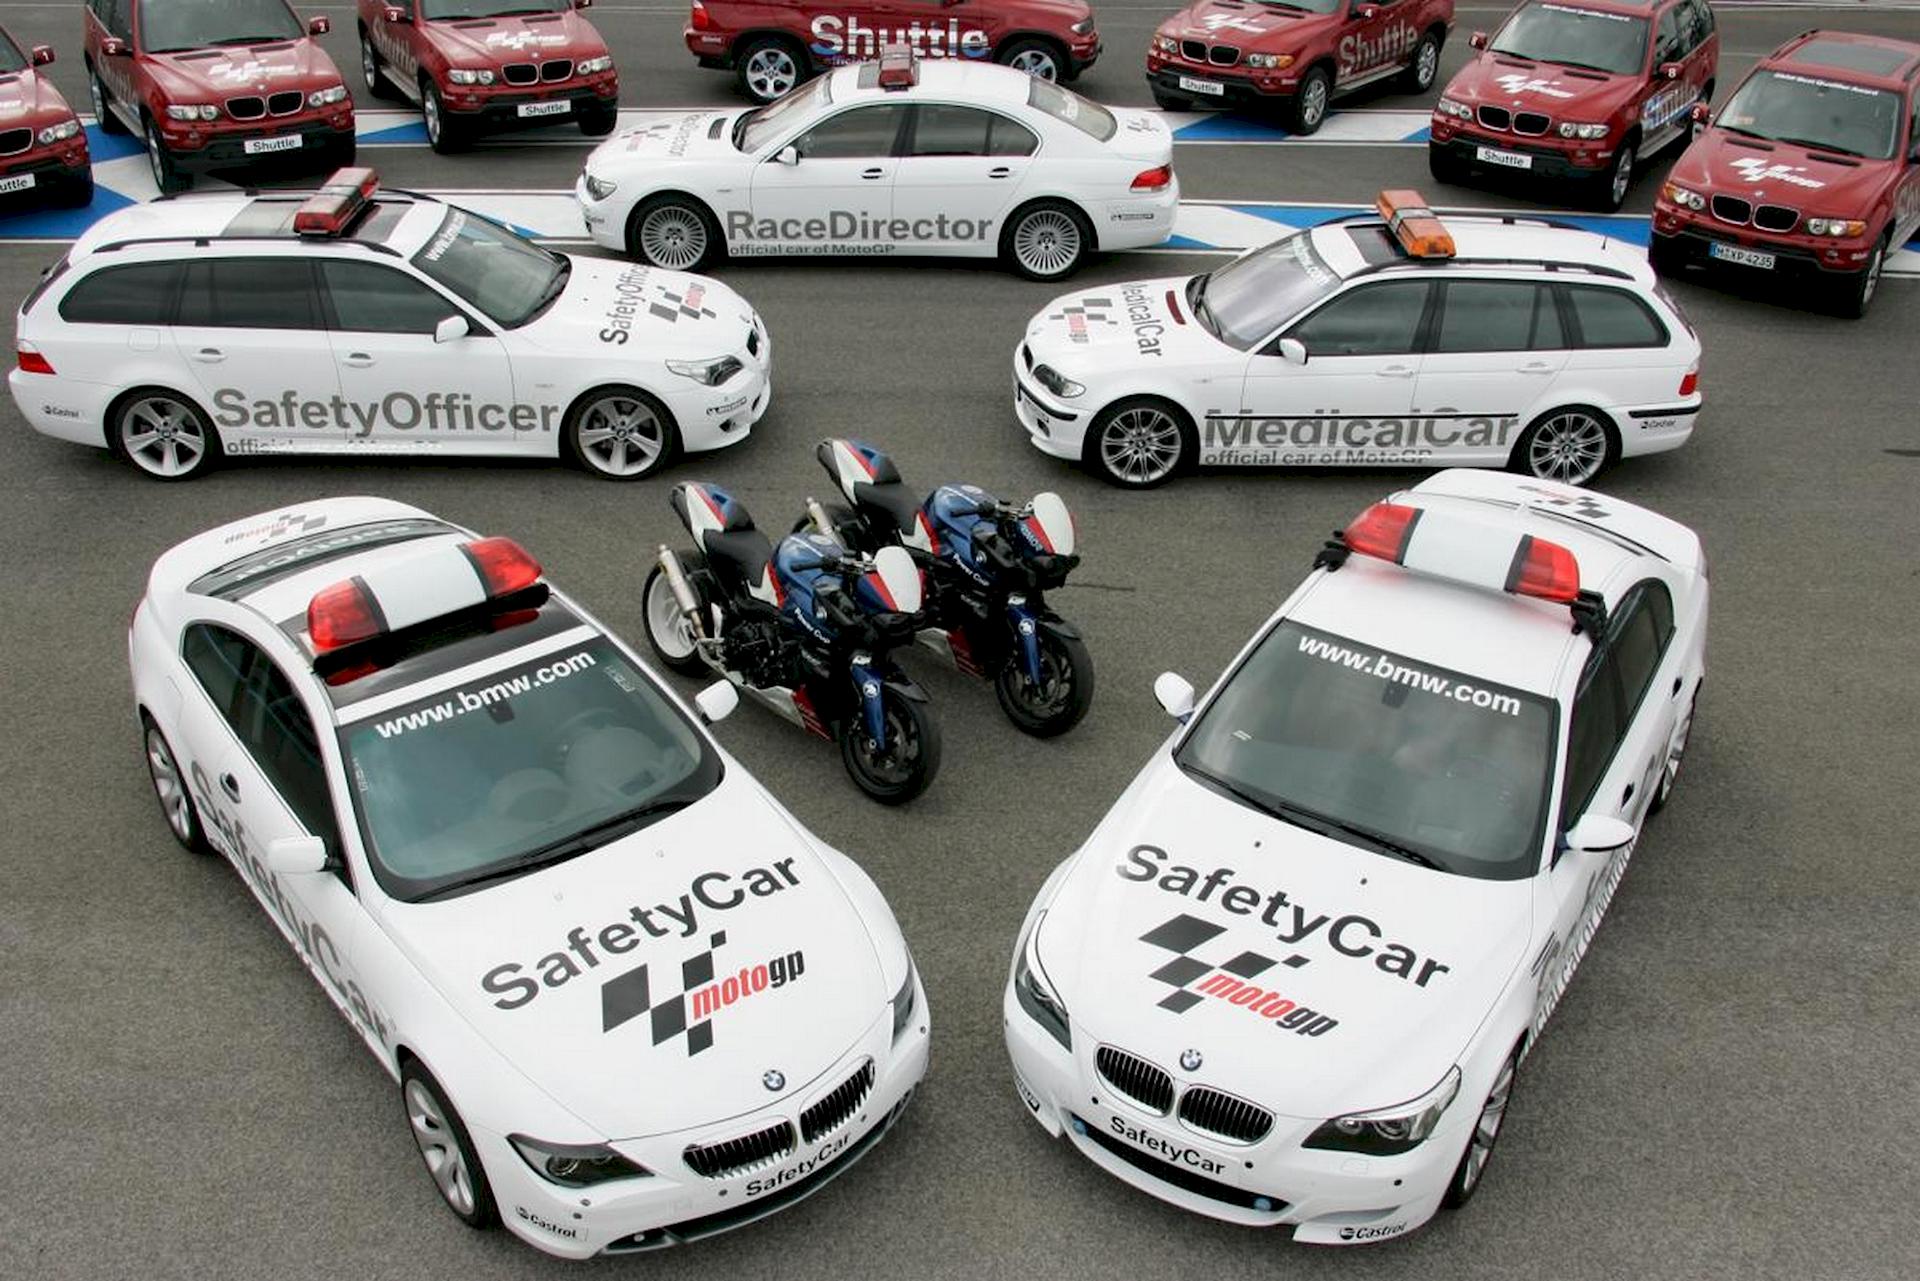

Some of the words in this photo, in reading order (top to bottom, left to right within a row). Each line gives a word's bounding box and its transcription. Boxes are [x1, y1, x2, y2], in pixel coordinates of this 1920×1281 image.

[109, 43, 116, 54] 2
[810, 15, 990, 58] Shuttle
[1340, 19, 1418, 68] Shuttle
[42, 52, 49, 61] 1
[1667, 67, 1676, 79] 8
[525, 103, 563, 116] Shuttle
[253, 138, 295, 151] Shuttle
[1484, 150, 1525, 167] Shuttle
[726, 210, 993, 241] RaceDirector
[730, 244, 782, 257] official
[785, 245, 810, 255] car
[811, 244, 829, 255] of
[832, 244, 896, 255] MotoGP
[212, 388, 560, 438] SafetyOfficer
[1204, 407, 1520, 448] MedicalCar
[1204, 450, 1277, 466] official
[1282, 452, 1314, 465] car
[1318, 450, 1341, 465] of
[1345, 449, 1433, 465] MotoGP
[814, 630, 831, 644] Cup
[1299, 632, 1521, 718] www.bmw.com
[375, 648, 597, 740] www.bmw.com
[481, 856, 801, 1010] SafetyCar
[1116, 843, 1452, 988] SafetyCar
[692, 949, 805, 1020] motogp
[1195, 971, 1340, 1038] motogp
[1110, 1114, 1226, 1177] SafetyCar
[745, 1131, 852, 1198] SafetyCar
[529, 1212, 577, 1241] Castrol
[1356, 1221, 1407, 1239] Castrol
